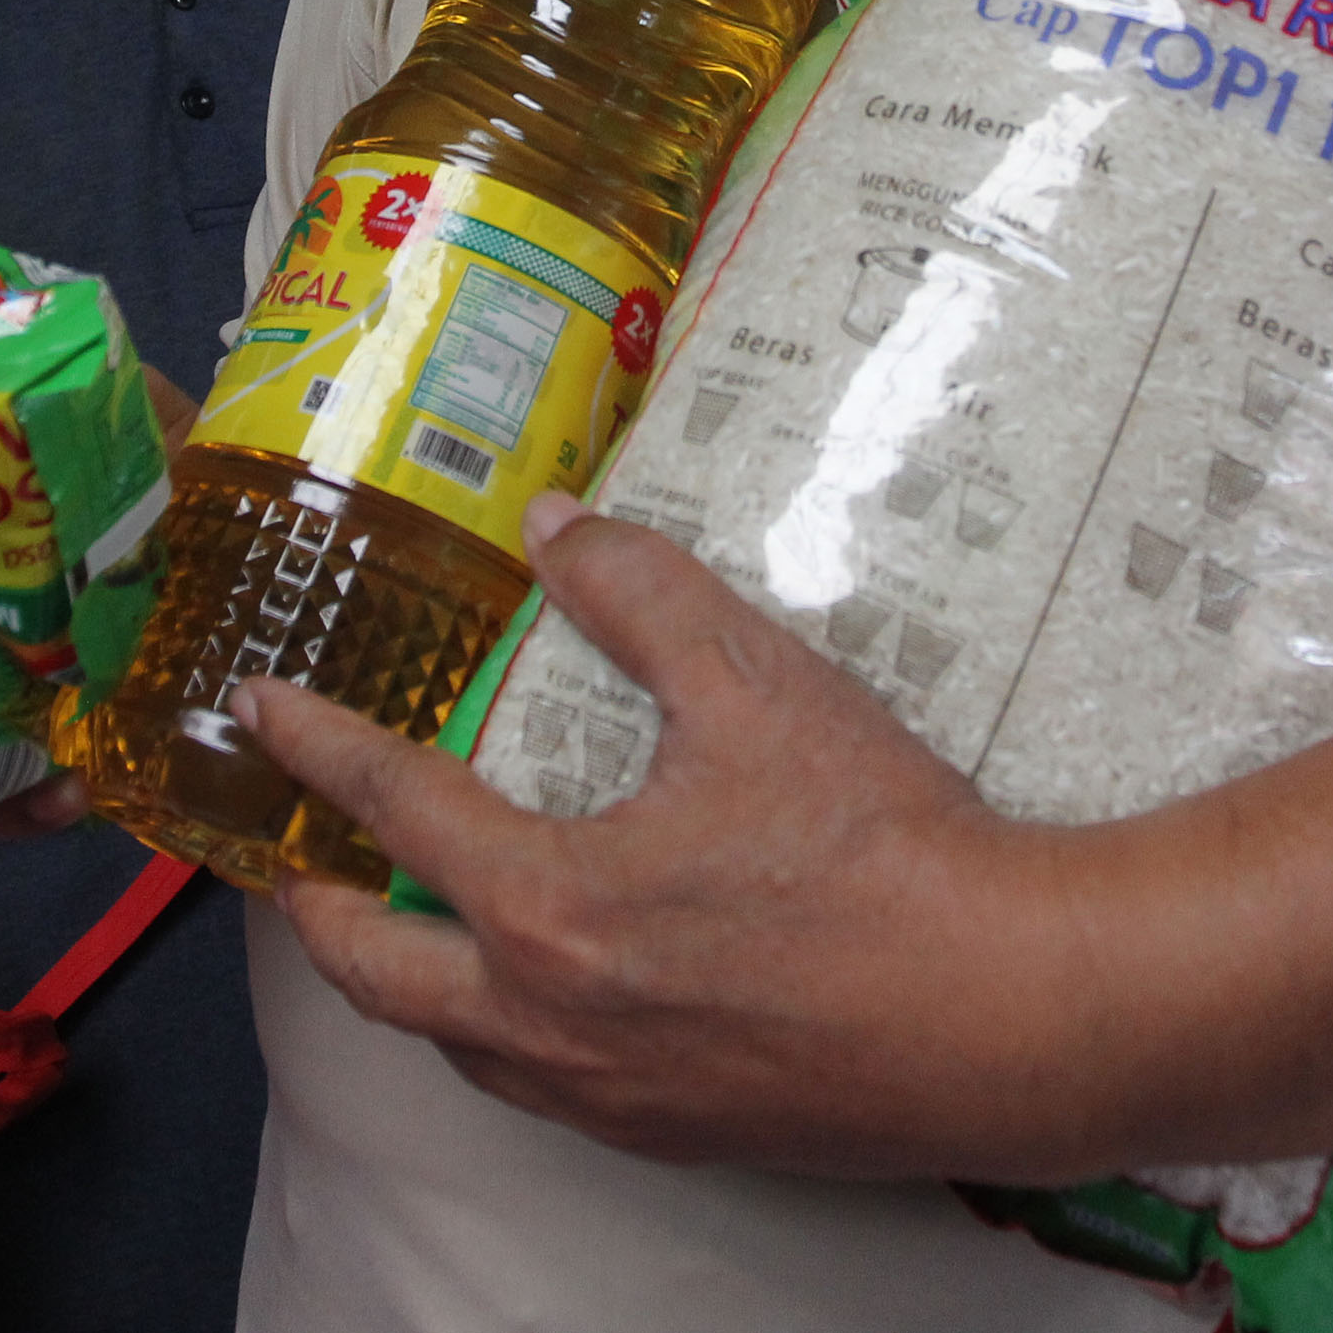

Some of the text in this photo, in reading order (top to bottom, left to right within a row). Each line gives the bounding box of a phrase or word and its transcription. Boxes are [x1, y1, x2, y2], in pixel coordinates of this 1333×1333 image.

[863, 93, 929, 124] Cara
[377, 188, 426, 227] 2x
[626, 302, 655, 344] 2x
[1238, 297, 1333, 369] Beras
[730, 327, 816, 365] Beras
[3, 537, 56, 572] asa
